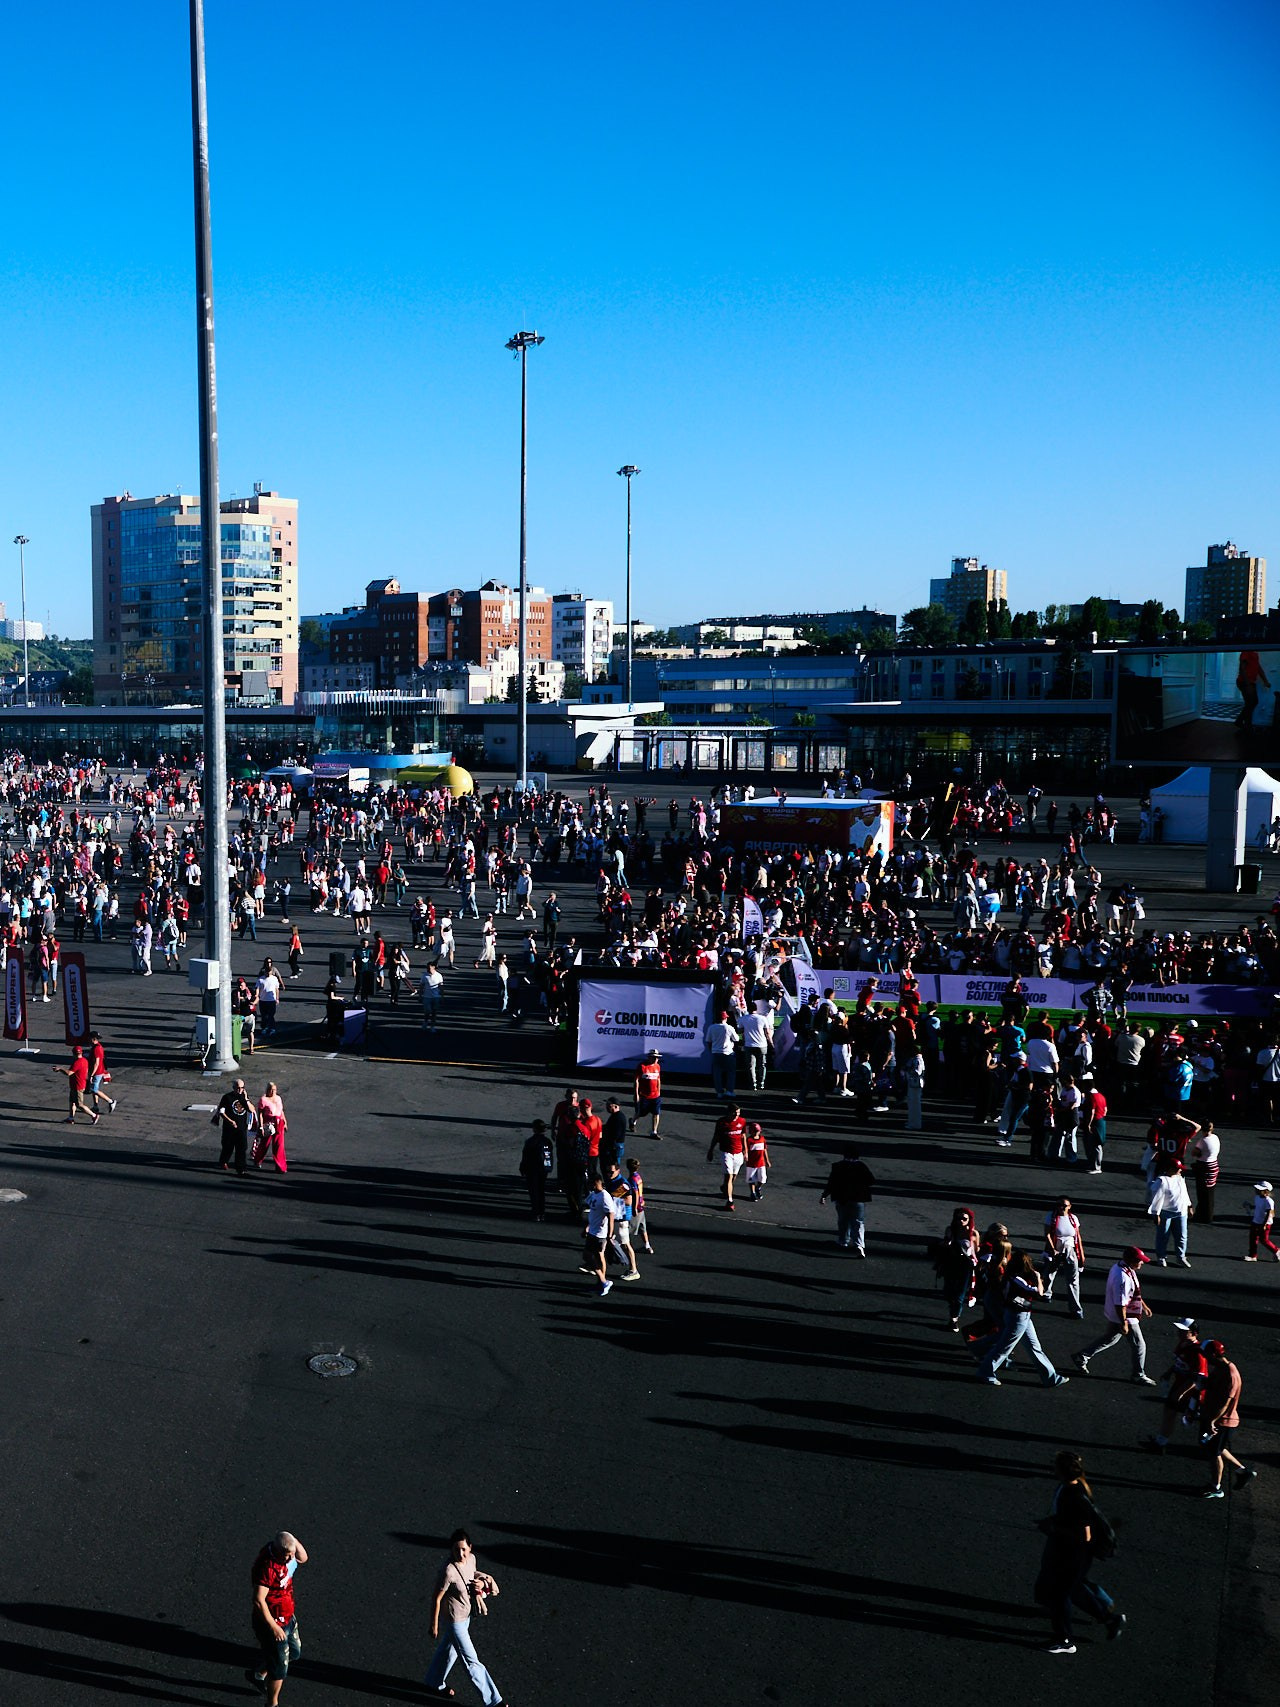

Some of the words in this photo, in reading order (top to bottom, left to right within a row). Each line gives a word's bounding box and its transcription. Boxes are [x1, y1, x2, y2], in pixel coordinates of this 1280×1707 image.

[966, 980, 1029, 992] ФЕСТИВЬ
[10, 963, 18, 1025] OLIMPBET
[70, 969, 81, 1032] OLIMPBET
[966, 991, 1048, 1003] БОЛЕЛИКОВ
[1122, 991, 1145, 1002] ВОИ
[1147, 992, 1190, 1004] ПЛЮСЫ
[615, 1012, 647, 1026] СВОИ
[649, 1013, 698, 1029] ПЛЮСЫ
[597, 1027, 639, 1036] ФЕСТИВАЛЬ
[640, 1028, 695, 1040] БОЛЕЛЬЩИКОВ
[1160, 1137, 1177, 1153] 10
